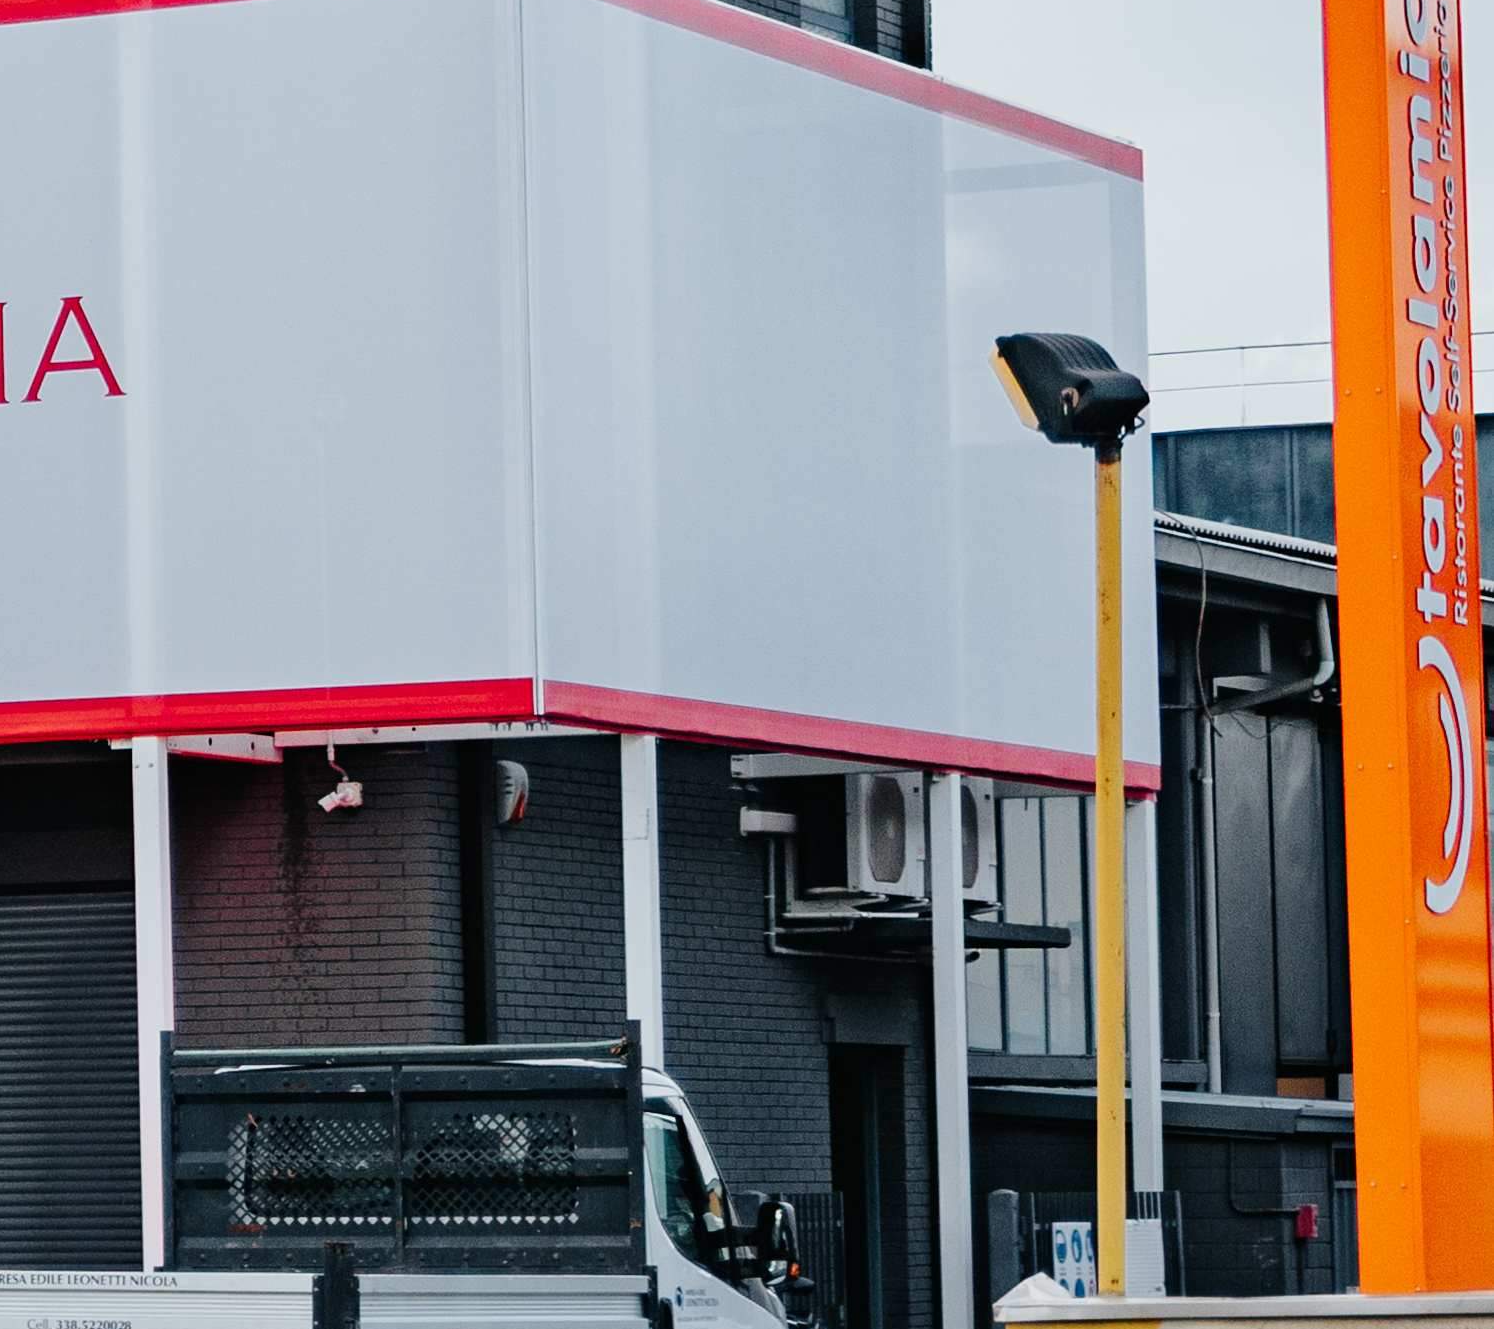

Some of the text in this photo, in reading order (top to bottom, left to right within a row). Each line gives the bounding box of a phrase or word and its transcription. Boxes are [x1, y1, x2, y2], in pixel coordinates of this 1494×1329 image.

[1433, 0, 1453, 161] Pizzeria
[1440, 174, 1462, 414] Self-Service
[1450, 424, 1468, 625] Ristorante
[30, 1274, 64, 1285] EDILE
[67, 1274, 126, 1286] LEONETTI
[129, 1275, 178, 1288] NICOLA
